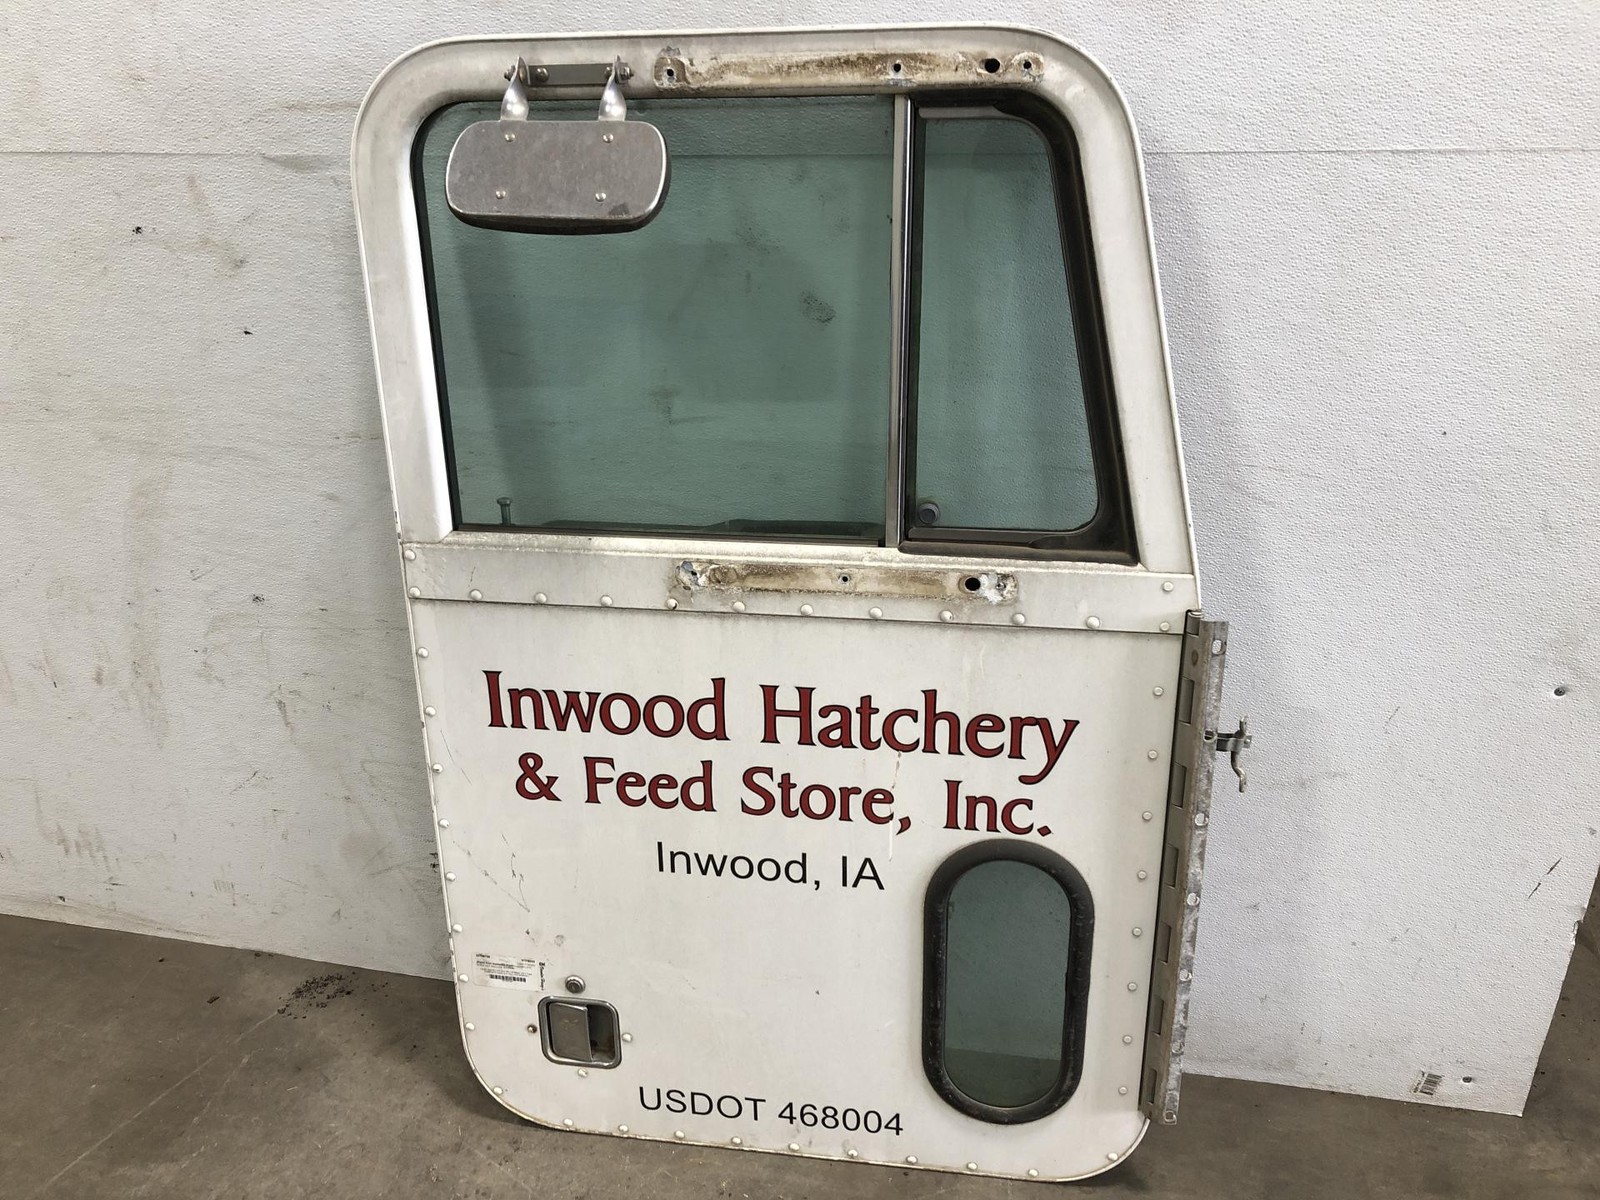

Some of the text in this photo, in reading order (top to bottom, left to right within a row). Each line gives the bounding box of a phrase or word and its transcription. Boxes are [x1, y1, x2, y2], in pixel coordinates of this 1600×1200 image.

[482, 669, 1081, 786] Inwood Hatchery
[515, 751, 1053, 838] & Feed Store, Inc.
[656, 841, 885, 891] Inwood, IA
[639, 1086, 904, 1136] USDOT 468004
